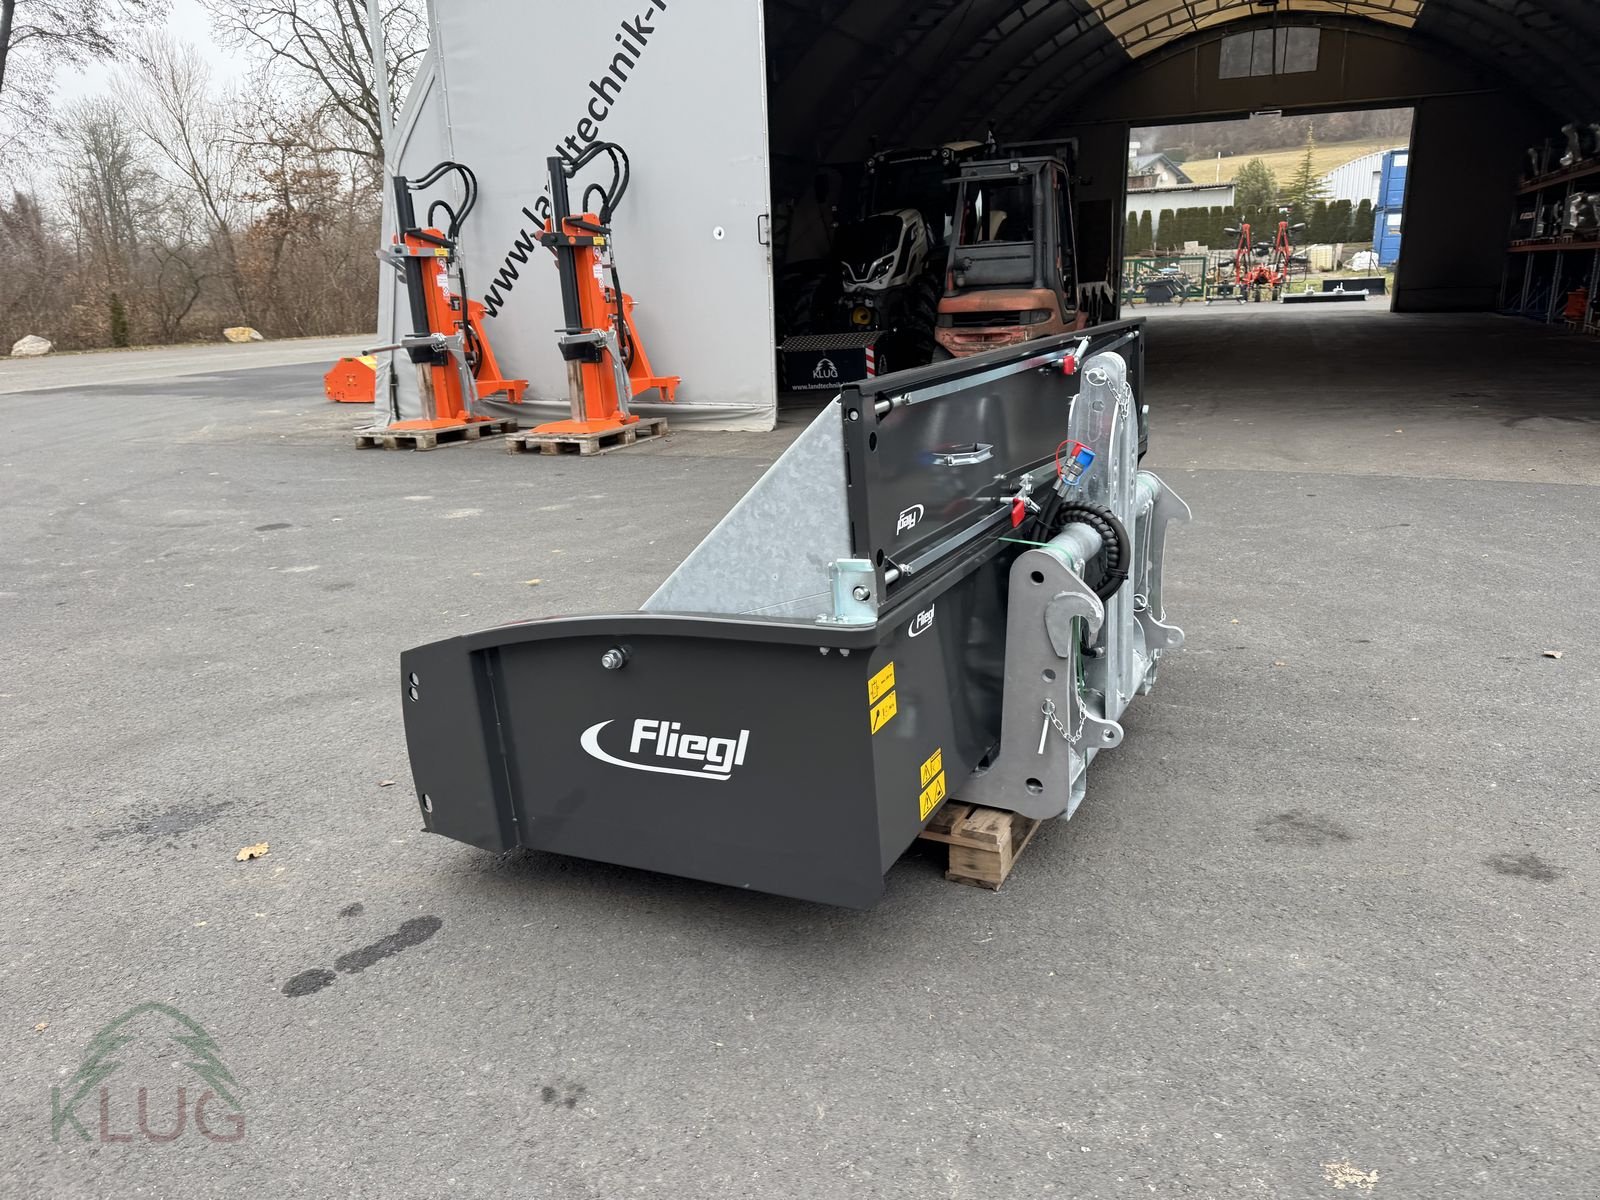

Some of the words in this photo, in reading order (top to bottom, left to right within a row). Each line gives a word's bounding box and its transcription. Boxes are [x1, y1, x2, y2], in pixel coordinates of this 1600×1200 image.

[484, 0, 667, 318] wwwlatechnik-
[812, 369, 838, 378] KLUG
[916, 603, 935, 629] Fliegl
[629, 718, 750, 773] Fliegl
